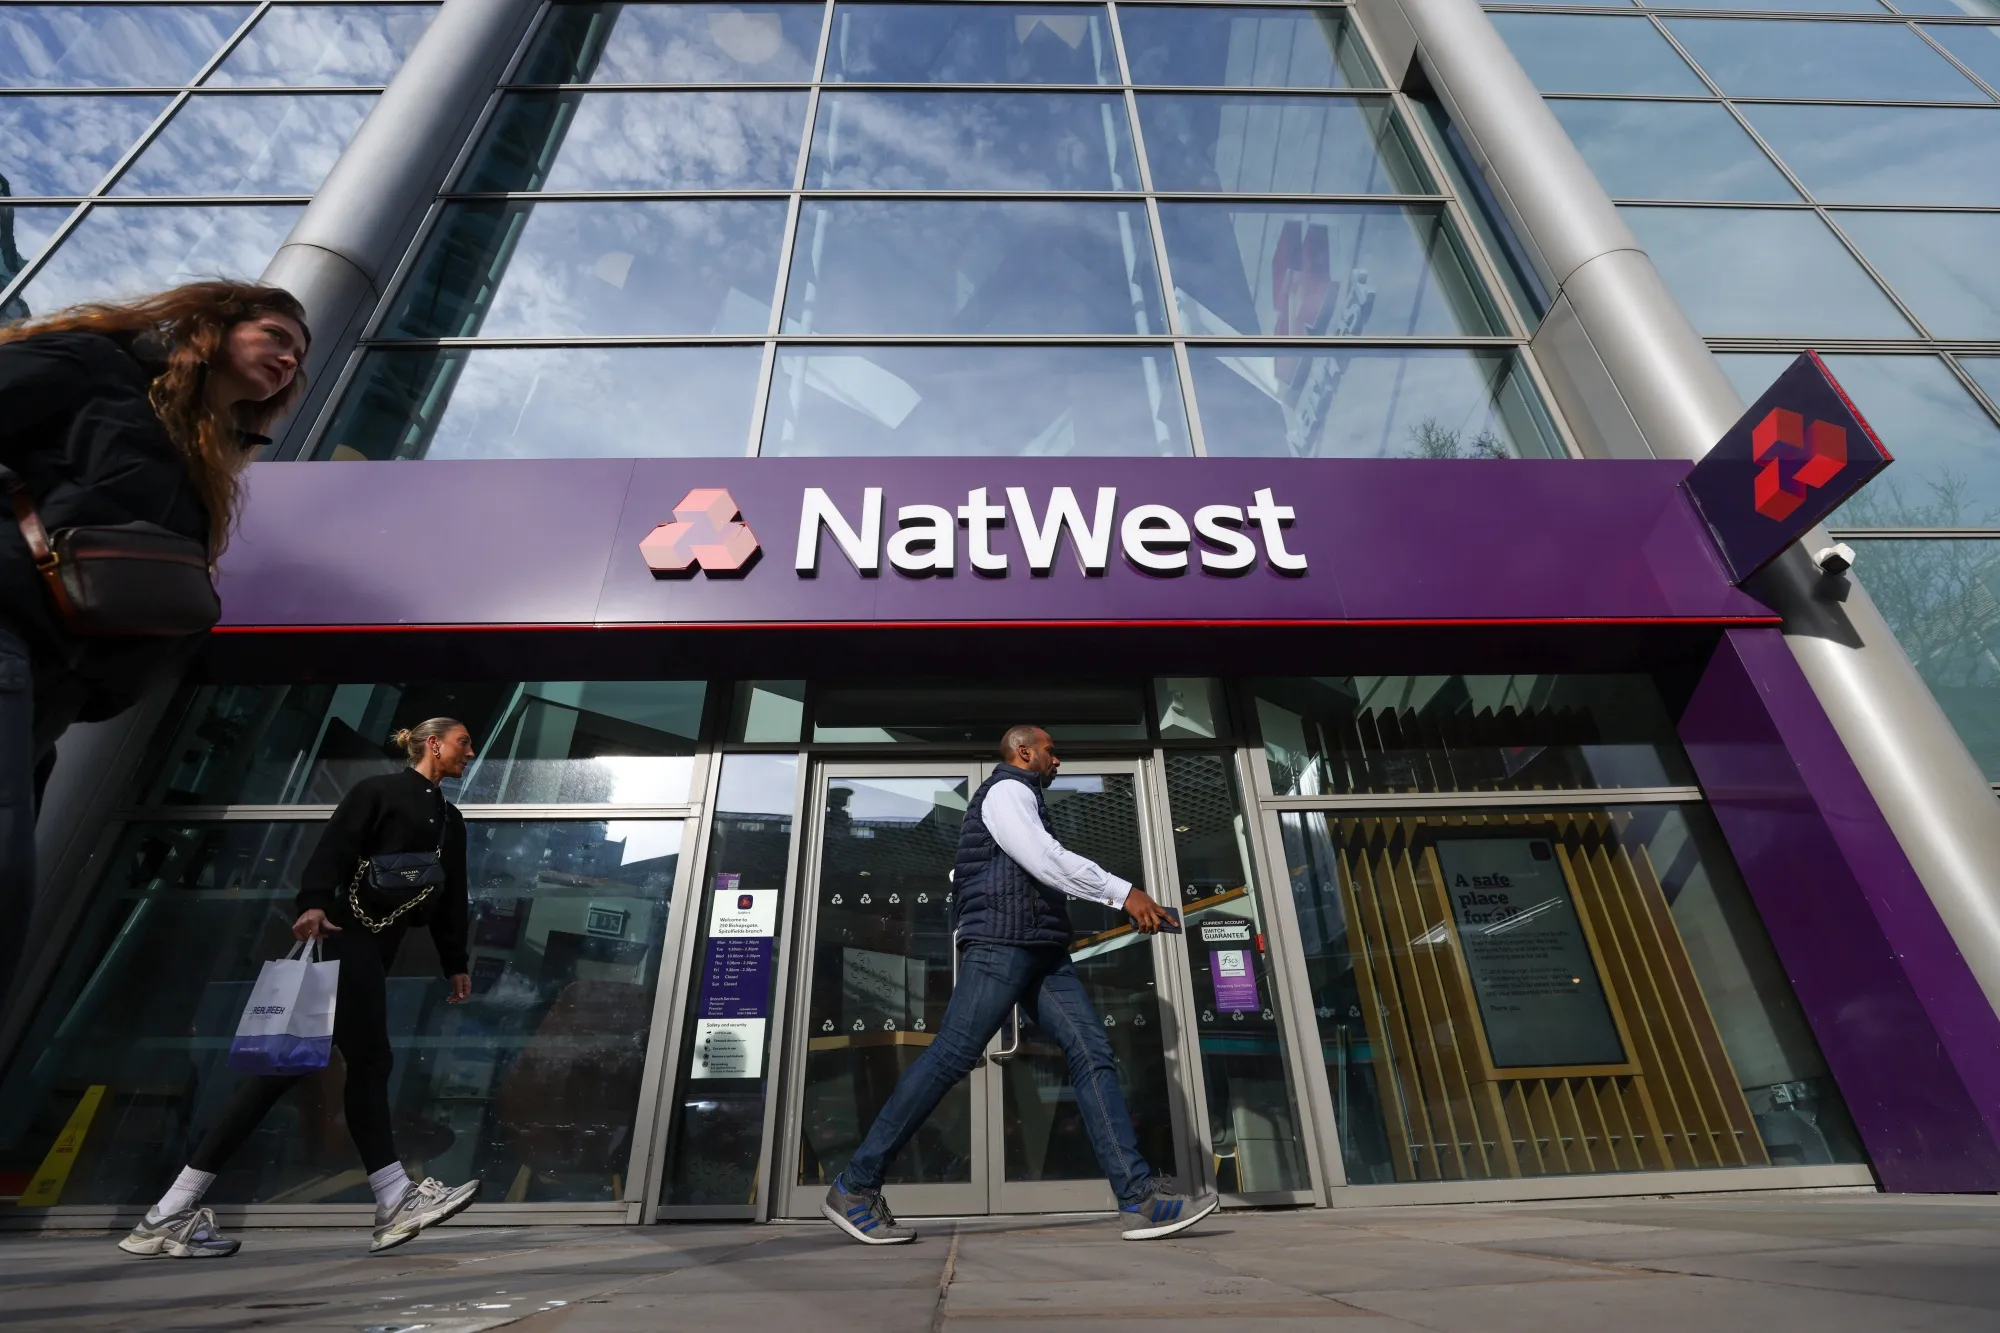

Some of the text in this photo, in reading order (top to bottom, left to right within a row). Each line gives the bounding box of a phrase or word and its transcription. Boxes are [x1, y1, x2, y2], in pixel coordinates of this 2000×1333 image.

[795, 486, 1308, 577] NatWest
[1455, 872, 1511, 887] A safe
[1459, 891, 1509, 909] place
[1464, 910, 1492, 924] for
